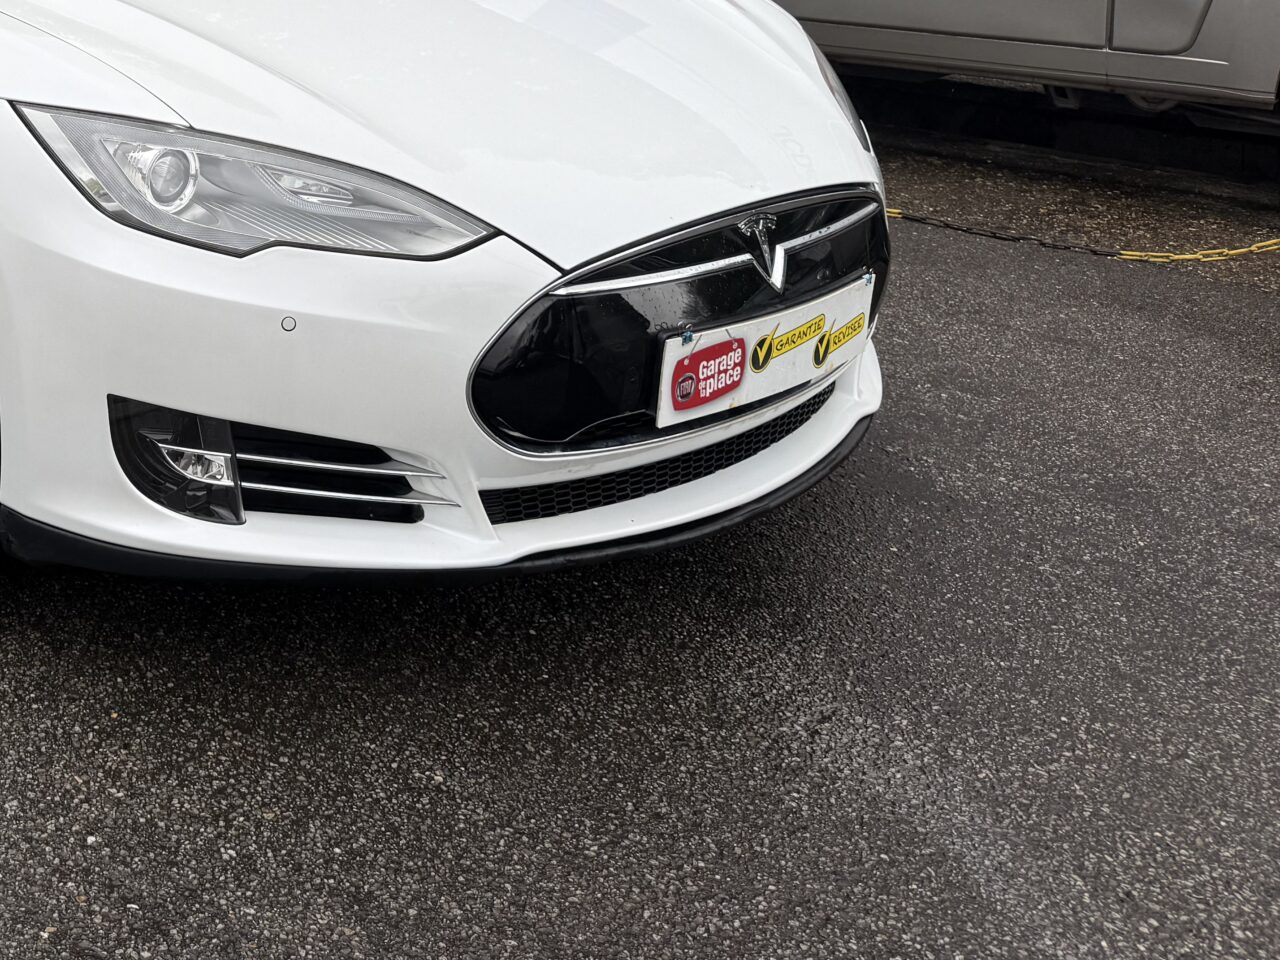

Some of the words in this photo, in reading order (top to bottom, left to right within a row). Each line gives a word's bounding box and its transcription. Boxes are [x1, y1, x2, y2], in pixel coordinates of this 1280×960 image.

[775, 318, 824, 352] GARANTIE
[699, 347, 742, 380] Garage
[706, 366, 741, 397] place
